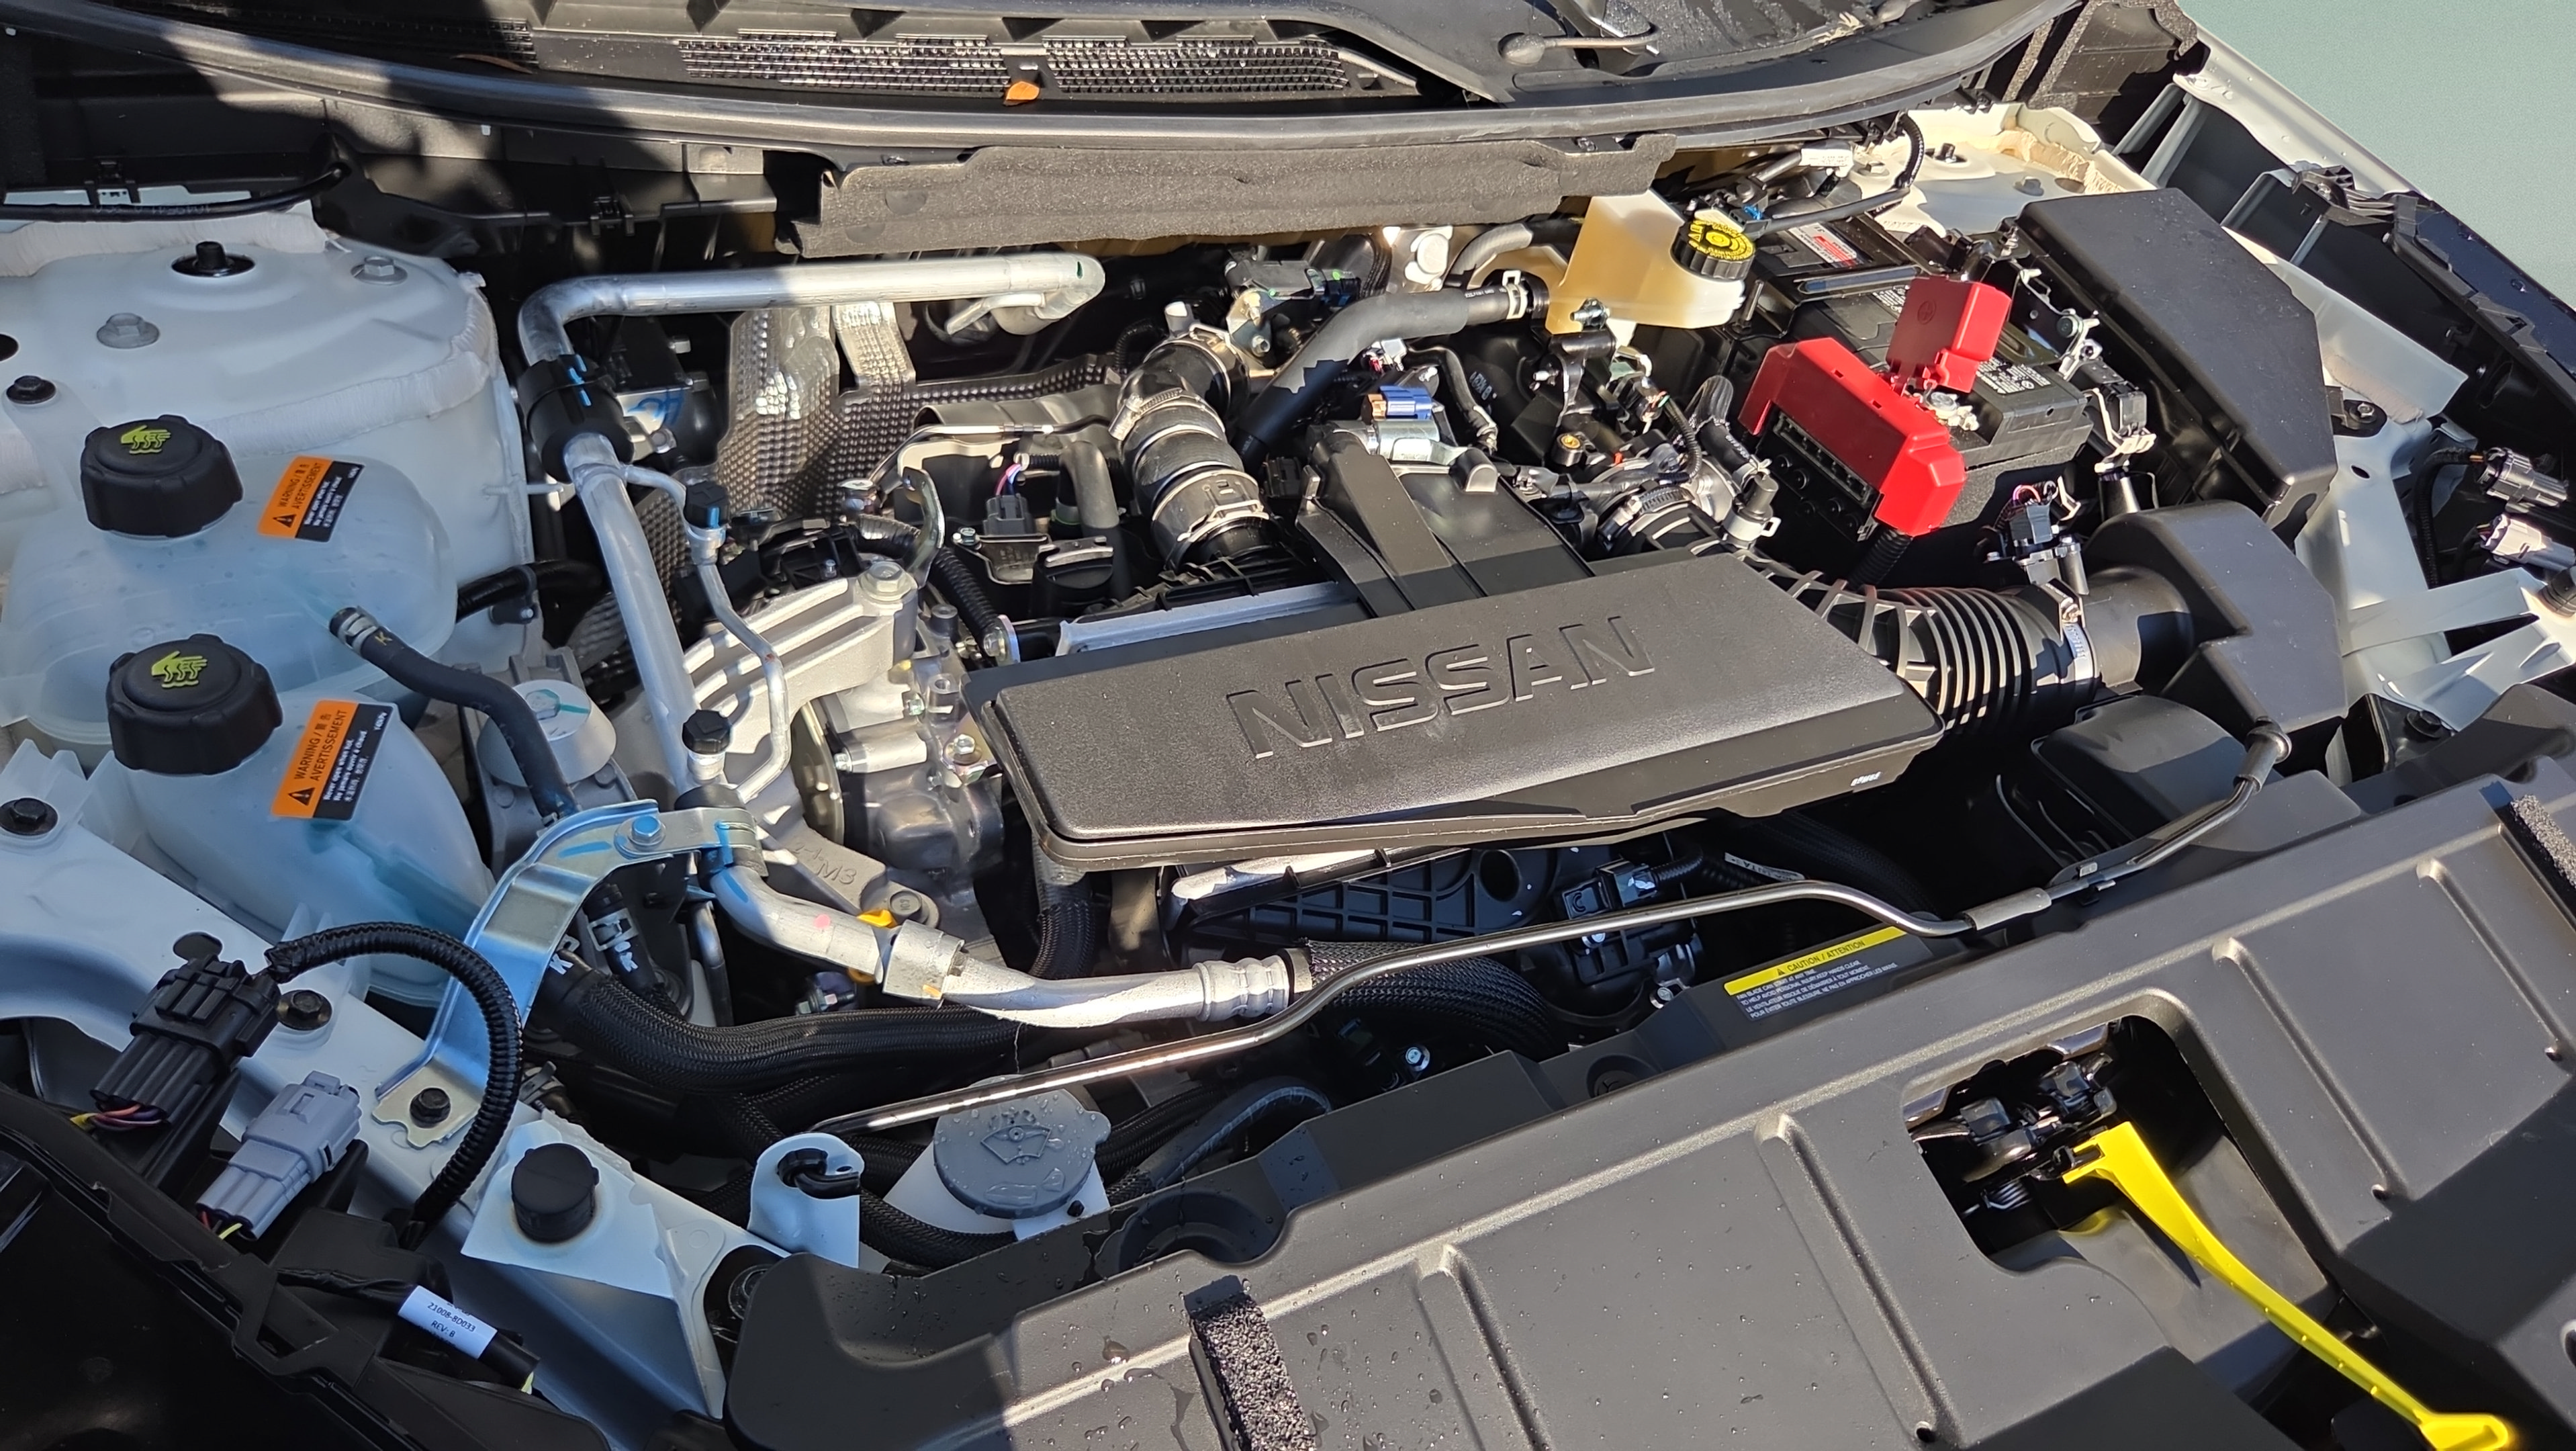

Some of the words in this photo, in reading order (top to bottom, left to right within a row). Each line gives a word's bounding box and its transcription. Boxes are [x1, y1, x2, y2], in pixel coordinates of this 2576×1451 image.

[277, 478, 300, 507] WARNING
[291, 463, 324, 509] AVERTISSEMENT
[1226, 615, 1655, 758] NISSAN
[294, 738, 320, 779] WARNING
[310, 710, 347, 781] AVERTISSEMENT
[323, 783, 336, 800] Never
[332, 767, 342, 781] open
[1787, 956, 1820, 971] CAUTION
[1827, 940, 1866, 958] ATTENTION
[431, 1320, 449, 1334] REV:
